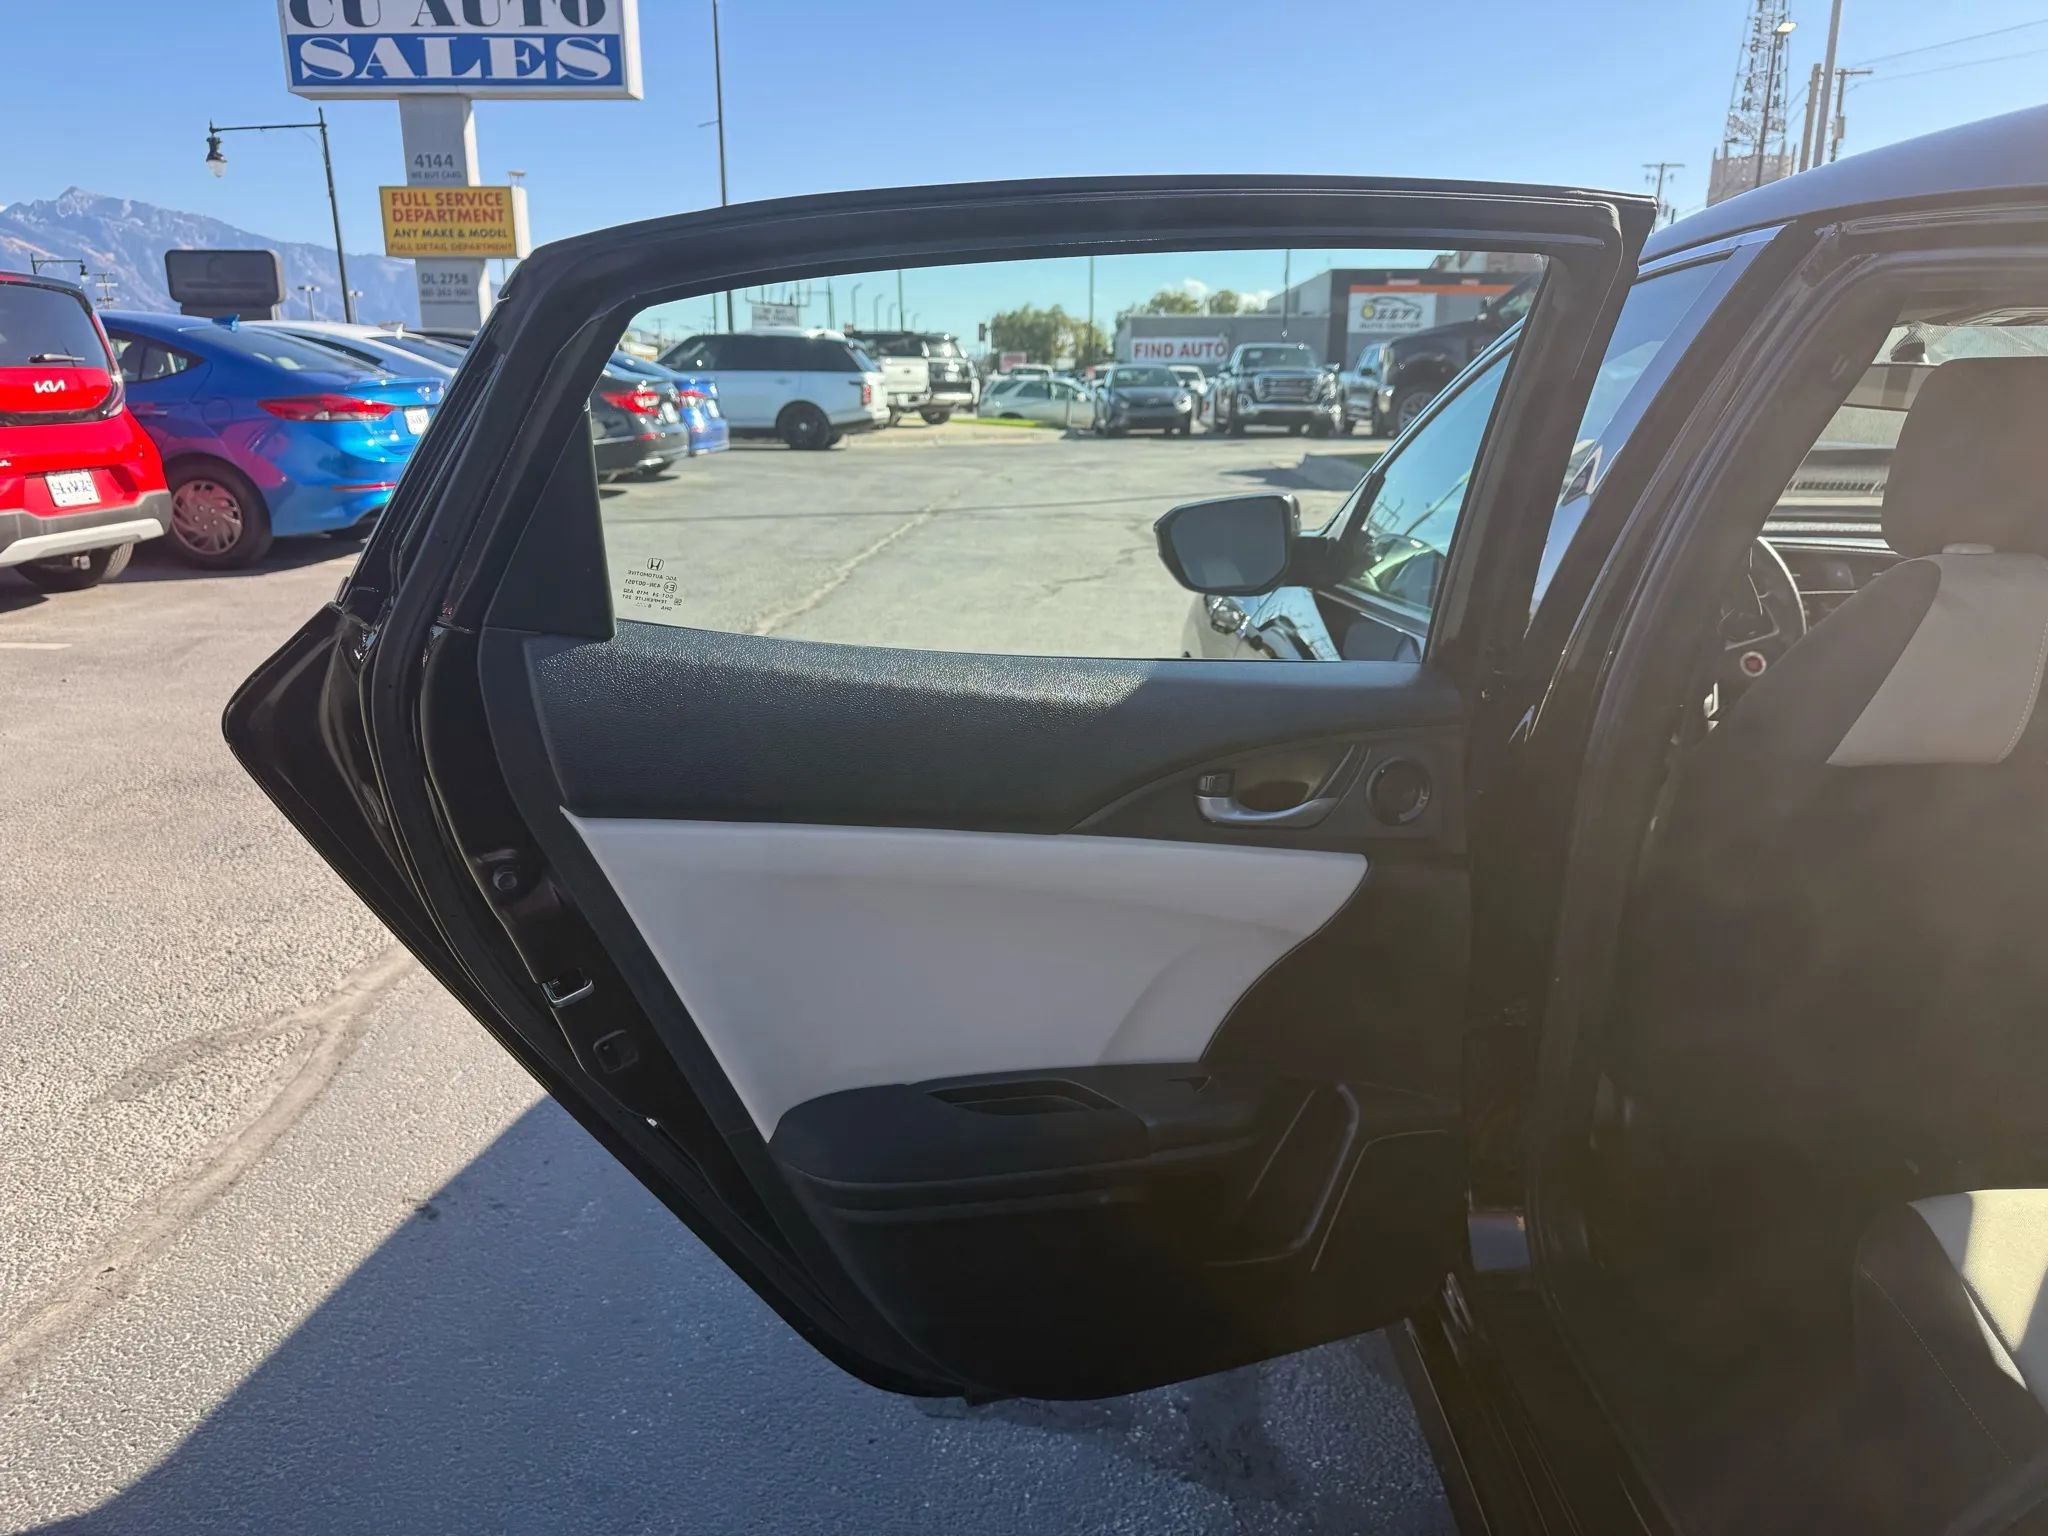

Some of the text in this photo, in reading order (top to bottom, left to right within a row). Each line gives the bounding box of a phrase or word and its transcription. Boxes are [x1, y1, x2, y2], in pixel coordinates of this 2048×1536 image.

[289, 0, 607, 28] CU AUTO
[299, 36, 612, 81] SALES
[414, 153, 454, 169] 4144
[391, 191, 504, 207] FULL SERVICE
[392, 208, 505, 223] DEPARTMENT
[393, 228, 418, 238] ANY
[422, 228, 454, 238] MAKE
[468, 228, 508, 238] MODEL
[1134, 341, 1227, 358] FIND AUTO
[33, 379, 66, 394] KIA
